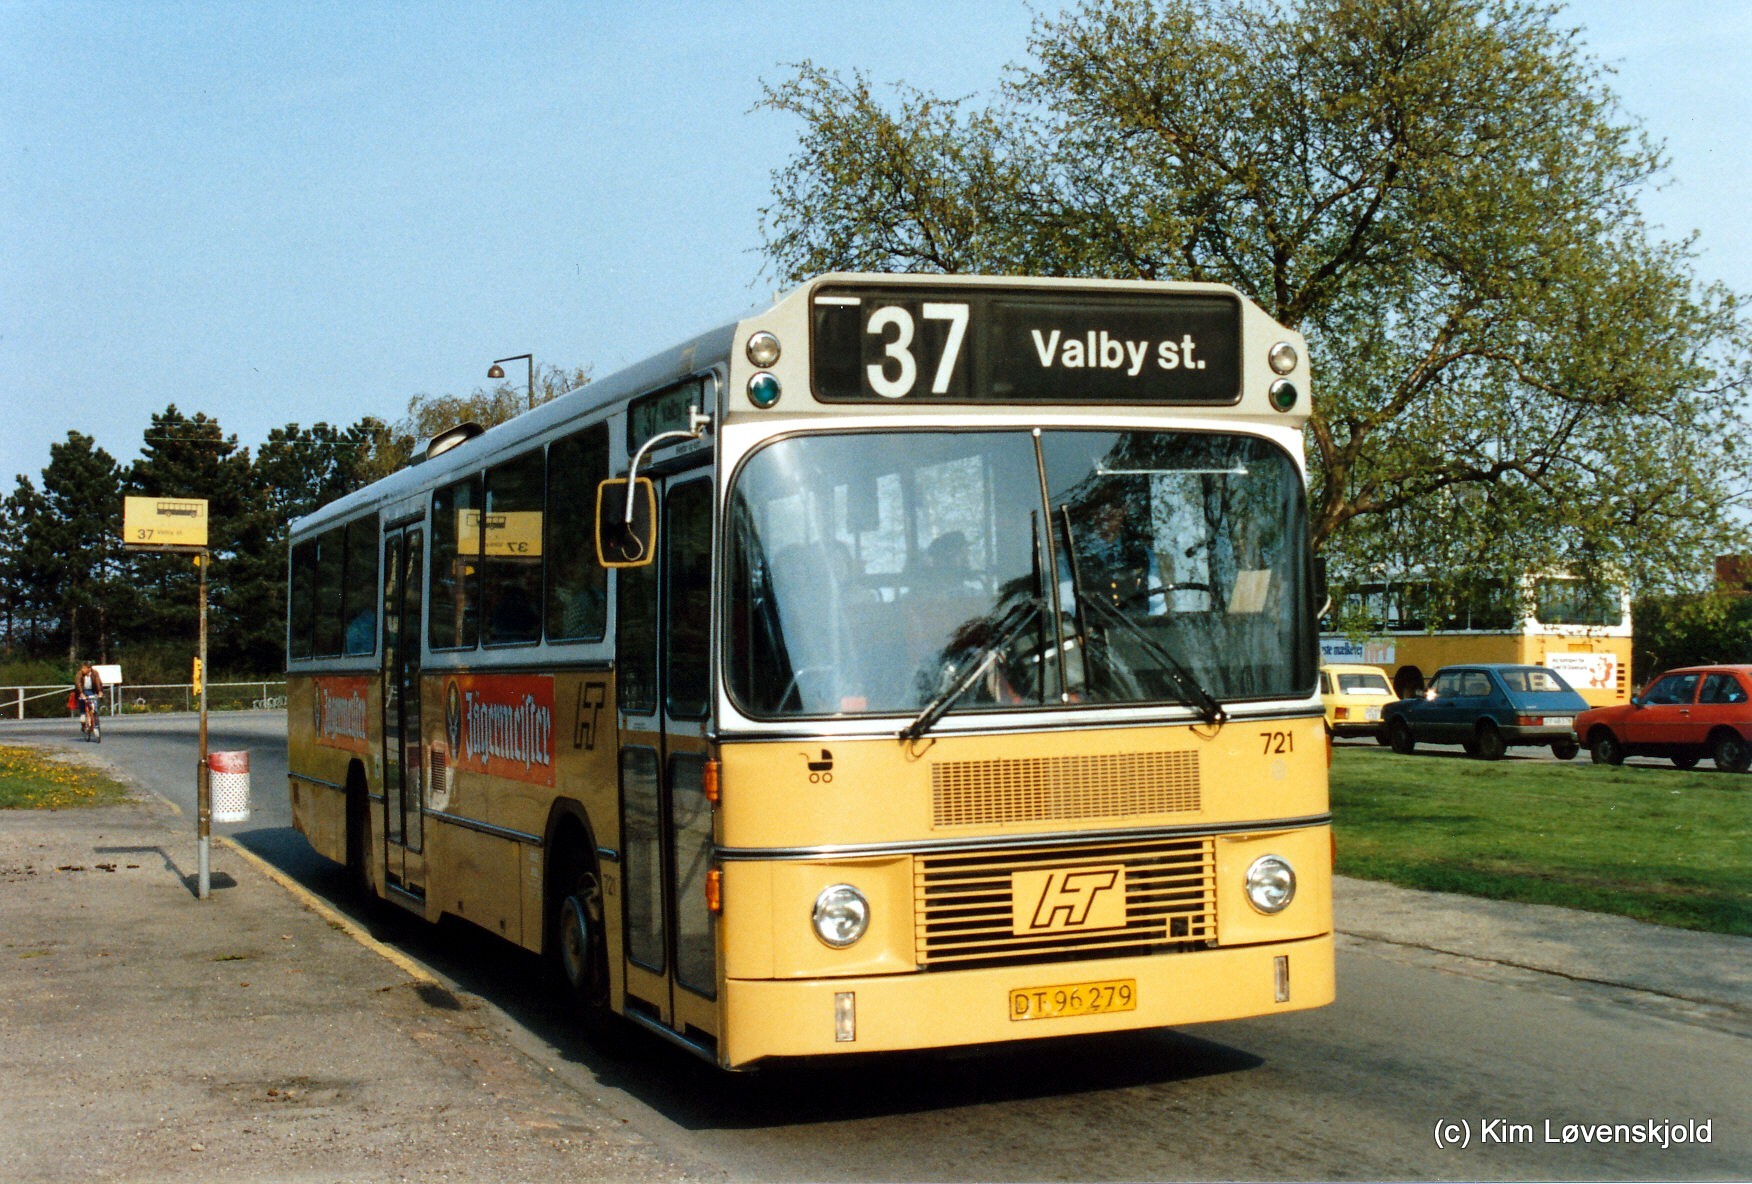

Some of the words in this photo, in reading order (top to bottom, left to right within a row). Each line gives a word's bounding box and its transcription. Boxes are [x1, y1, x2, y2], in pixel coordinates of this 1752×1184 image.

[867, 303, 970, 398] 37
[1032, 329, 1149, 376] Valby
[1158, 334, 1207, 370] st.
[137, 528, 154, 540] 37
[465, 690, 551, 773] Jägermeister
[1260, 730, 1293, 755] 721
[1029, 869, 1121, 930] HT
